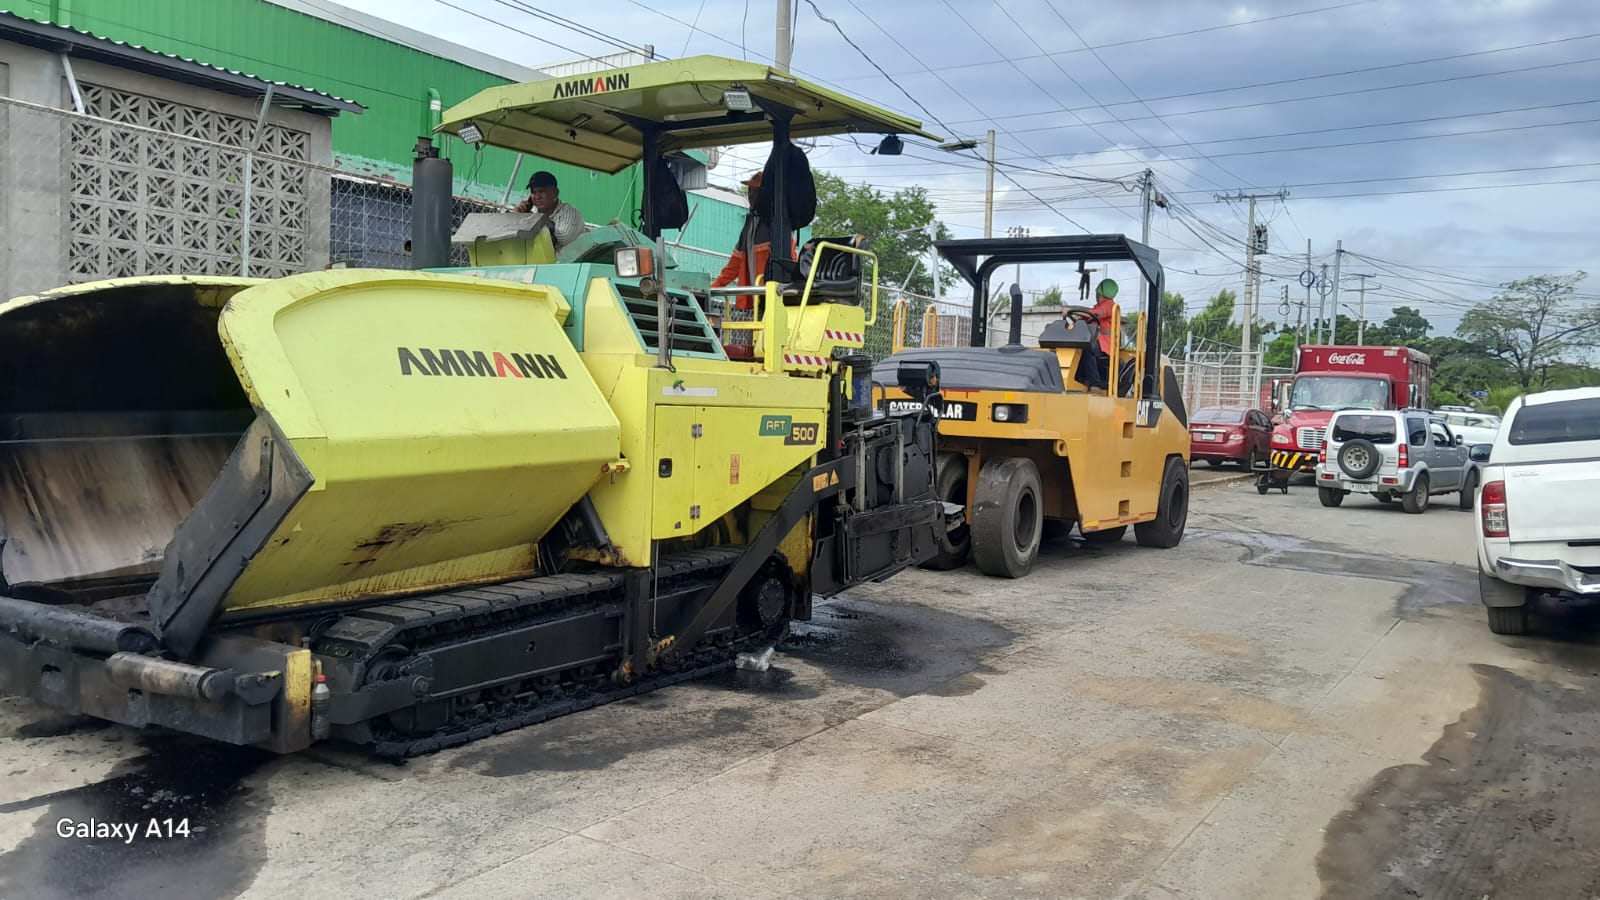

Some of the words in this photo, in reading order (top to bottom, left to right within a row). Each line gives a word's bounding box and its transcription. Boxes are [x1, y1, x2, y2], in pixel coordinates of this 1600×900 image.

[553, 72, 630, 99] AMMANN
[397, 347, 569, 380] AMMANN
[1328, 352, 1366, 365] Coca-Cola
[1136, 400, 1150, 425] CAT
[766, 420, 786, 431] AFT
[792, 427, 815, 441] 500
